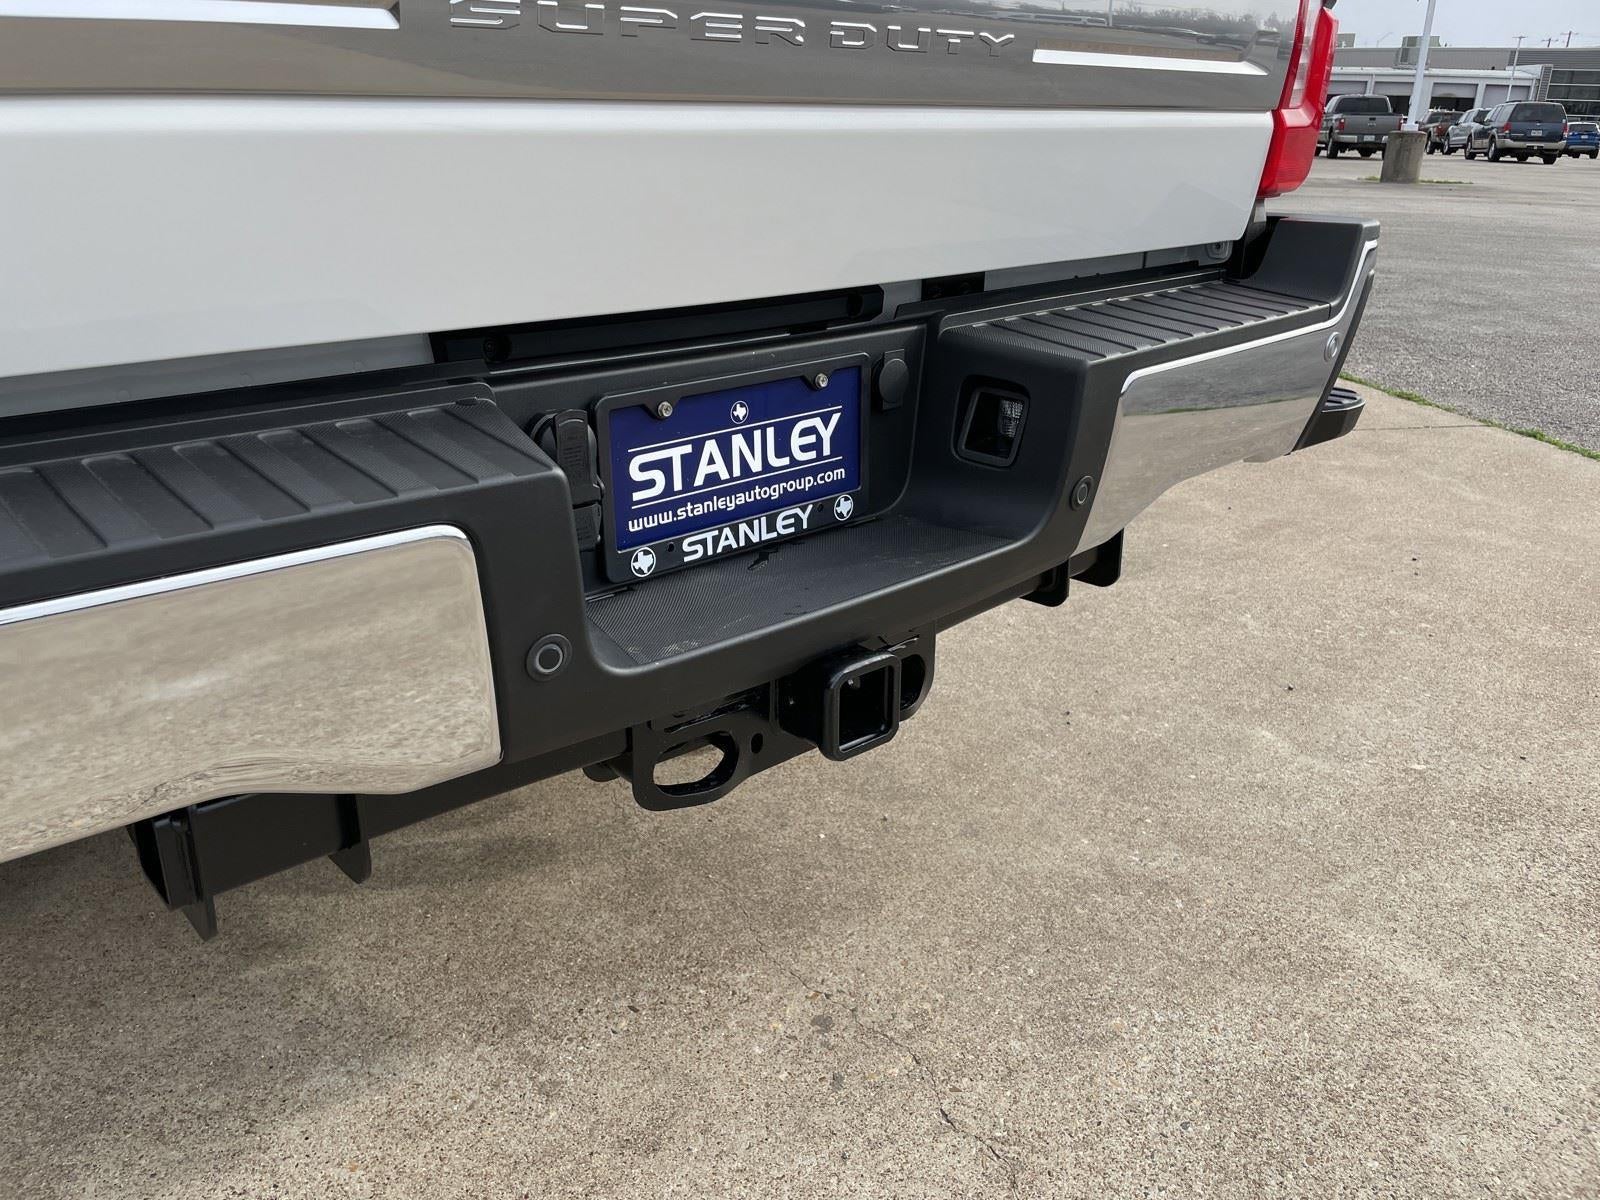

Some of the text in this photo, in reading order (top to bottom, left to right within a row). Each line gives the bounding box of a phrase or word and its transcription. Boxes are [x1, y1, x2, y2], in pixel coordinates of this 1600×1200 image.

[449, 0, 1015, 57] SUPER DUTY
[628, 413, 842, 501] STANLEY
[628, 468, 846, 532] www.stanleyautogroup.com
[682, 504, 814, 562] STANLEY
